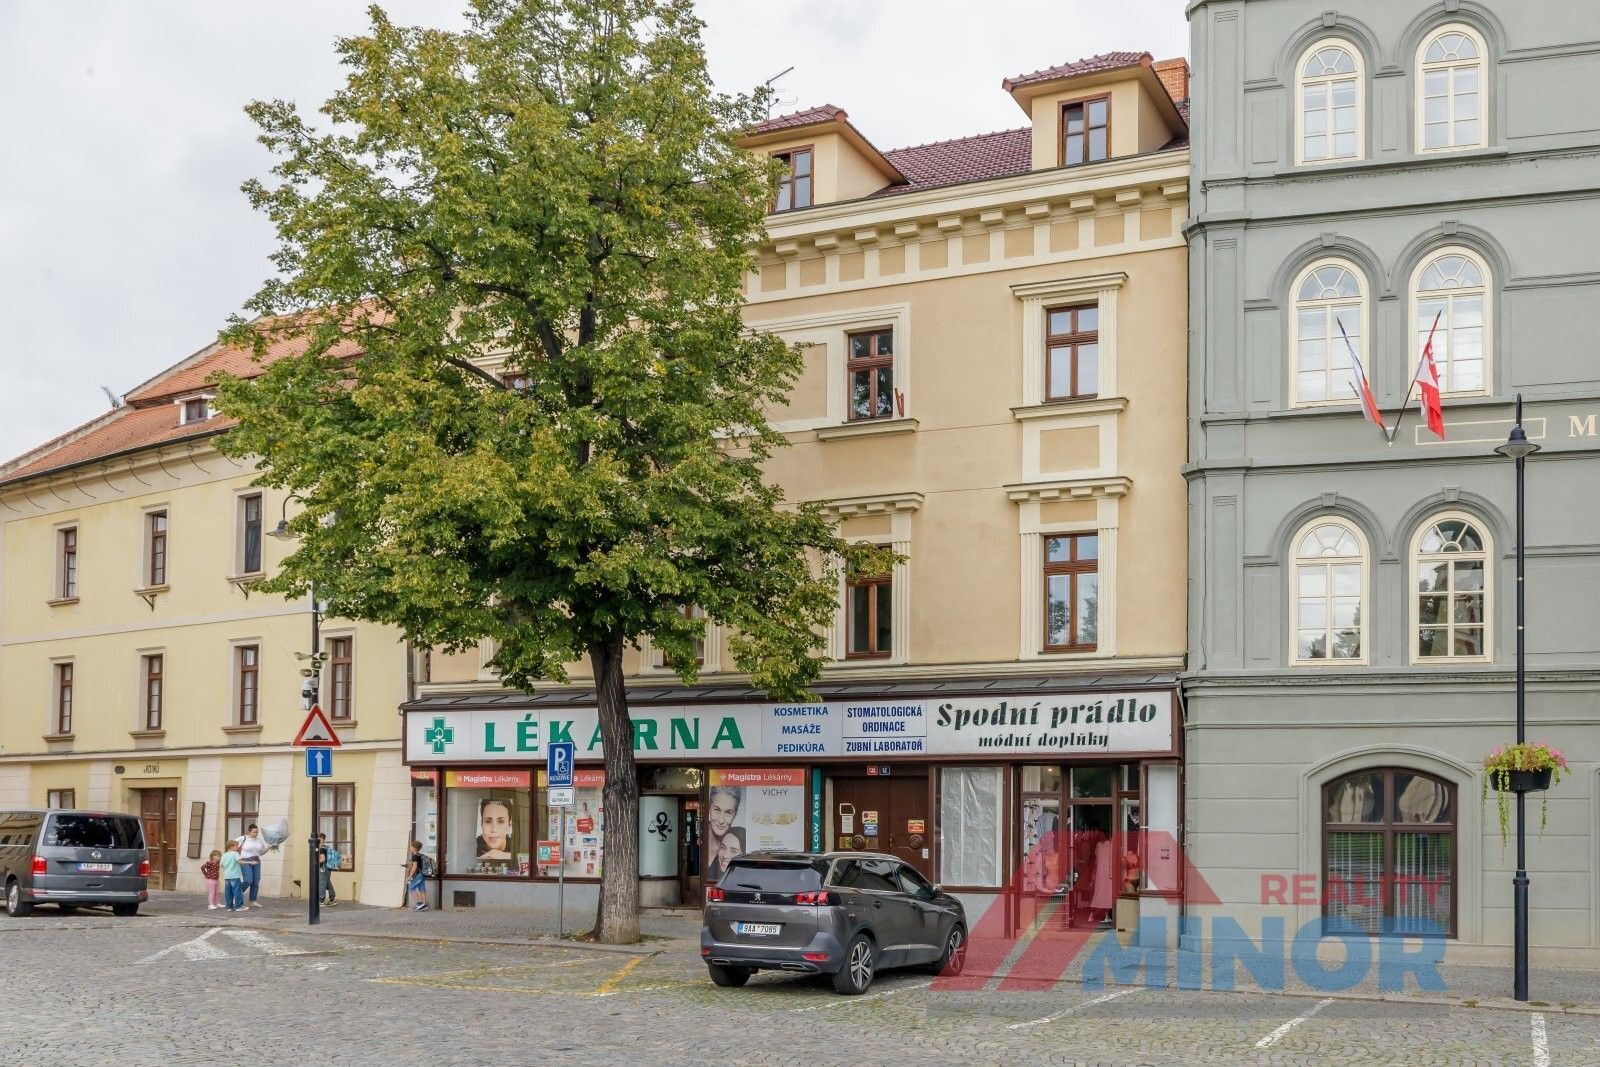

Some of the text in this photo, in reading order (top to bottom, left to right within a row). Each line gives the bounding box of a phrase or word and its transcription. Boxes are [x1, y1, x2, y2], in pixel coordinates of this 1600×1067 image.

[774, 706, 829, 717] KOSMETIKA
[847, 704, 922, 718] STOMATOLOGICKÁ
[936, 698, 1157, 731] Spodní prádlo
[781, 723, 821, 735] MASÁŽE
[862, 721, 905, 733] ORDINACE
[846, 738, 923, 752] ZUBNÍ LABORATOŘ
[978, 731, 1109, 749] módní doplňky
[777, 741, 825, 753] PEDIKÚRA
[554, 747, 567, 772] P
[463, 775, 520, 784] Magistra Lékárny
[728, 773, 793, 782] Magistra Lékárny
[762, 788, 789, 797] VICHY
[743, 925, 756, 933] 9AA
